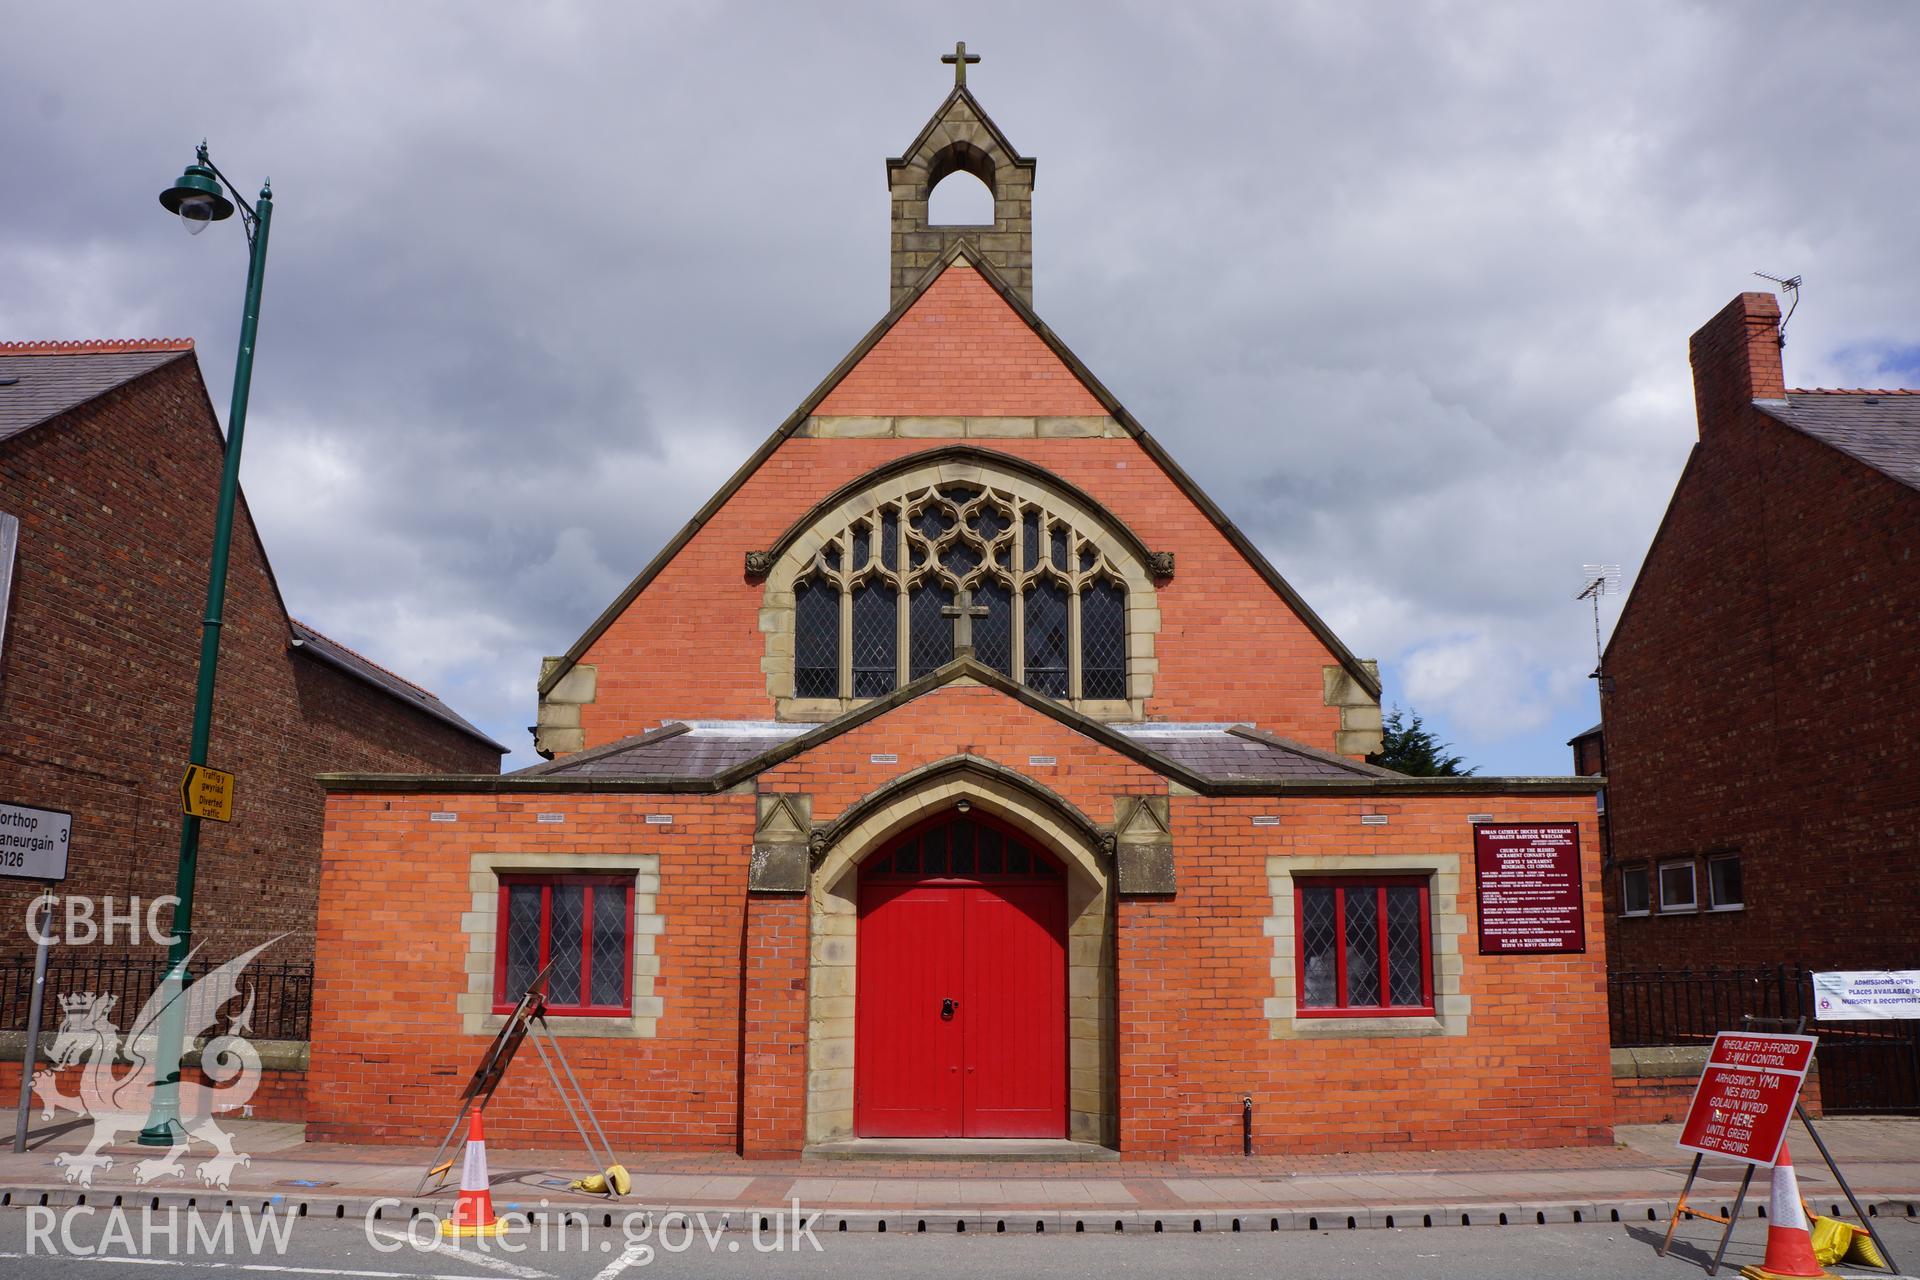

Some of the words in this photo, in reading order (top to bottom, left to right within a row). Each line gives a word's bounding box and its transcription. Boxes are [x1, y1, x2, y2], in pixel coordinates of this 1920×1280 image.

[199, 795, 223, 808] Diverted
[203, 808, 219, 818] traffic
[0, 810, 37, 832] orthop
[60, 829, 68, 843] 3
[1722, 1040, 1761, 1052] RHEOLAETH
[1762, 1042, 1800, 1054] 3-FFORDD
[1725, 1052, 1750, 1063] 3-WAY
[1751, 1053, 1785, 1066] CONTROL
[1715, 1073, 1756, 1086] ARHOSWCH
[1758, 1075, 1780, 1089] YMA
[1724, 1086, 1739, 1097] NES
[1740, 1089, 1760, 1100] BYDD
[1710, 1096, 1739, 1109] GOLAU'N
[1741, 1102, 1768, 1114] WYRDD
[1730, 1112, 1756, 1128] HERE
[1706, 1124, 1725, 1136] UNTIL
[1727, 1128, 1752, 1141] GREEN
[1700, 1135, 1720, 1148] LIGHT
[1721, 1139, 1749, 1153] SHOWS
